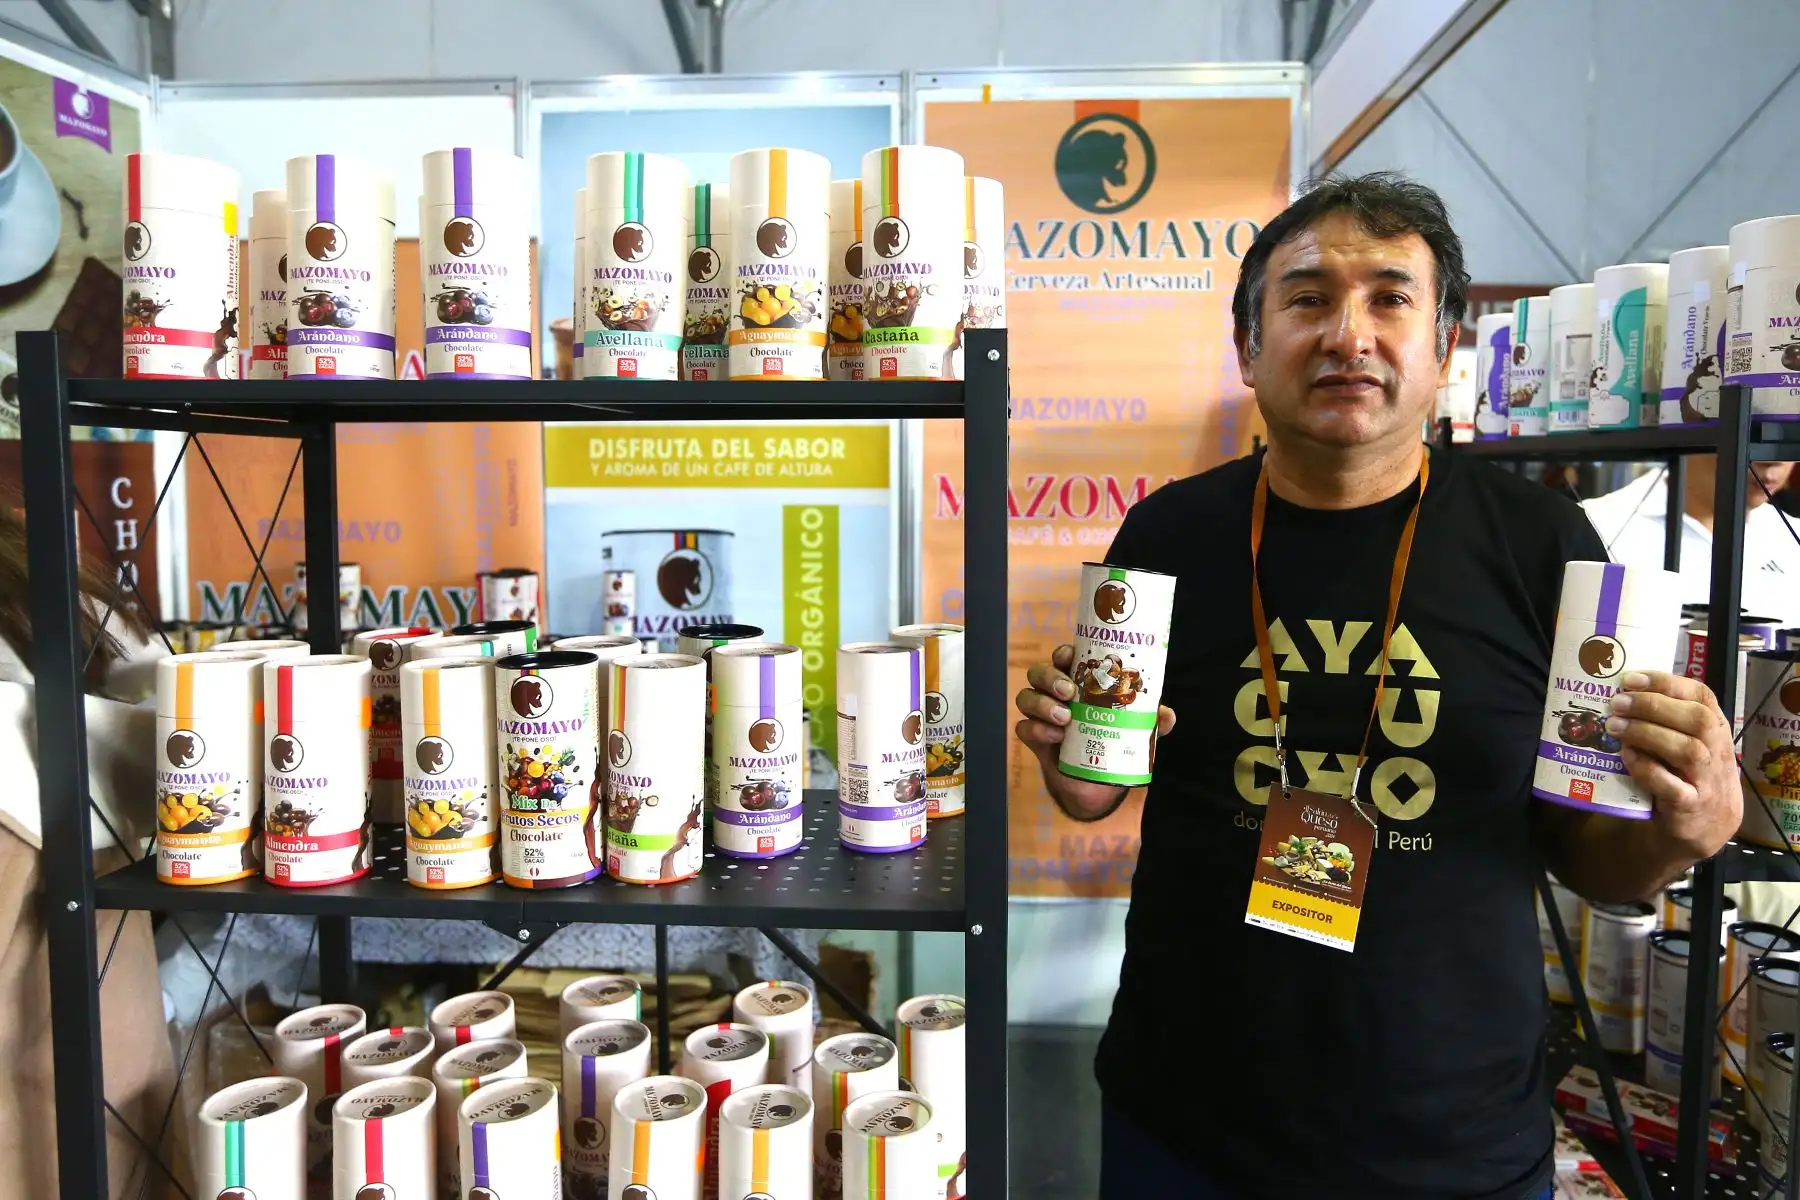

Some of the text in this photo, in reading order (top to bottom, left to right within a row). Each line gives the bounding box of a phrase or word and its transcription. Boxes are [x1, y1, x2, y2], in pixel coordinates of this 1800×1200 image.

[290, 266, 371, 283] MAZOMAYO
[429, 262, 508, 277] MAZOMAYO
[593, 267, 672, 284] MAZOMAYO
[738, 263, 816, 278] MAZOMAYO
[863, 262, 932, 278] MAZOMAYO
[1100, 270, 1212, 290] Artesanal
[299, 331, 361, 344] Arándano
[437, 329, 497, 341] Arándano
[596, 333, 664, 348] Avellana
[865, 328, 919, 344] Castaña
[1681, 305, 1698, 370] Arándano
[305, 346, 344, 355] Chocolate
[444, 344, 483, 353] Chocolate
[609, 348, 646, 358] Chocolate
[750, 347, 794, 357] Chocolate
[871, 346, 907, 356] Chocolate
[1625, 329, 1639, 388] Avellana
[589, 438, 846, 459] DISFRUTA DEL SABOR
[591, 463, 601, 476] Y
[604, 463, 657, 477] AROMA
[662, 462, 681, 477] DE
[686, 462, 708, 476] UN
[755, 462, 775, 477] DE
[780, 462, 833, 477] ALTURA
[795, 507, 824, 672] ORGÁNICO
[1076, 622, 1155, 647] MAZOMAYO
[1584, 695, 1600, 703] PONE
[1085, 706, 1116, 723] Coco
[1078, 722, 1121, 739] Grageas
[1087, 739, 1106, 750] 52%
[729, 752, 798, 768] MAZOMAYO
[1553, 746, 1624, 771] Arándano
[1560, 764, 1607, 782] Chocolate
[405, 776, 478, 790] MAZOMAYO
[1574, 781, 1591, 791] 52%
[1572, 788, 1591, 797] CACAO
[511, 795, 557, 809] Mix De
[537, 813, 579, 827] Secos
[738, 813, 792, 825] Arándano
[510, 829, 564, 842] Chocolate
[747, 827, 781, 836] Chocolate
[266, 836, 319, 851] Almendra
[1389, 830, 1433, 852] Perú
[162, 849, 202, 861] Chocolate
[524, 848, 544, 857] 52%
[416, 856, 456, 866] Chocolate
[1272, 899, 1333, 924] EXPOSITOR
[469, 1088, 544, 1120] MAZOMAYO
